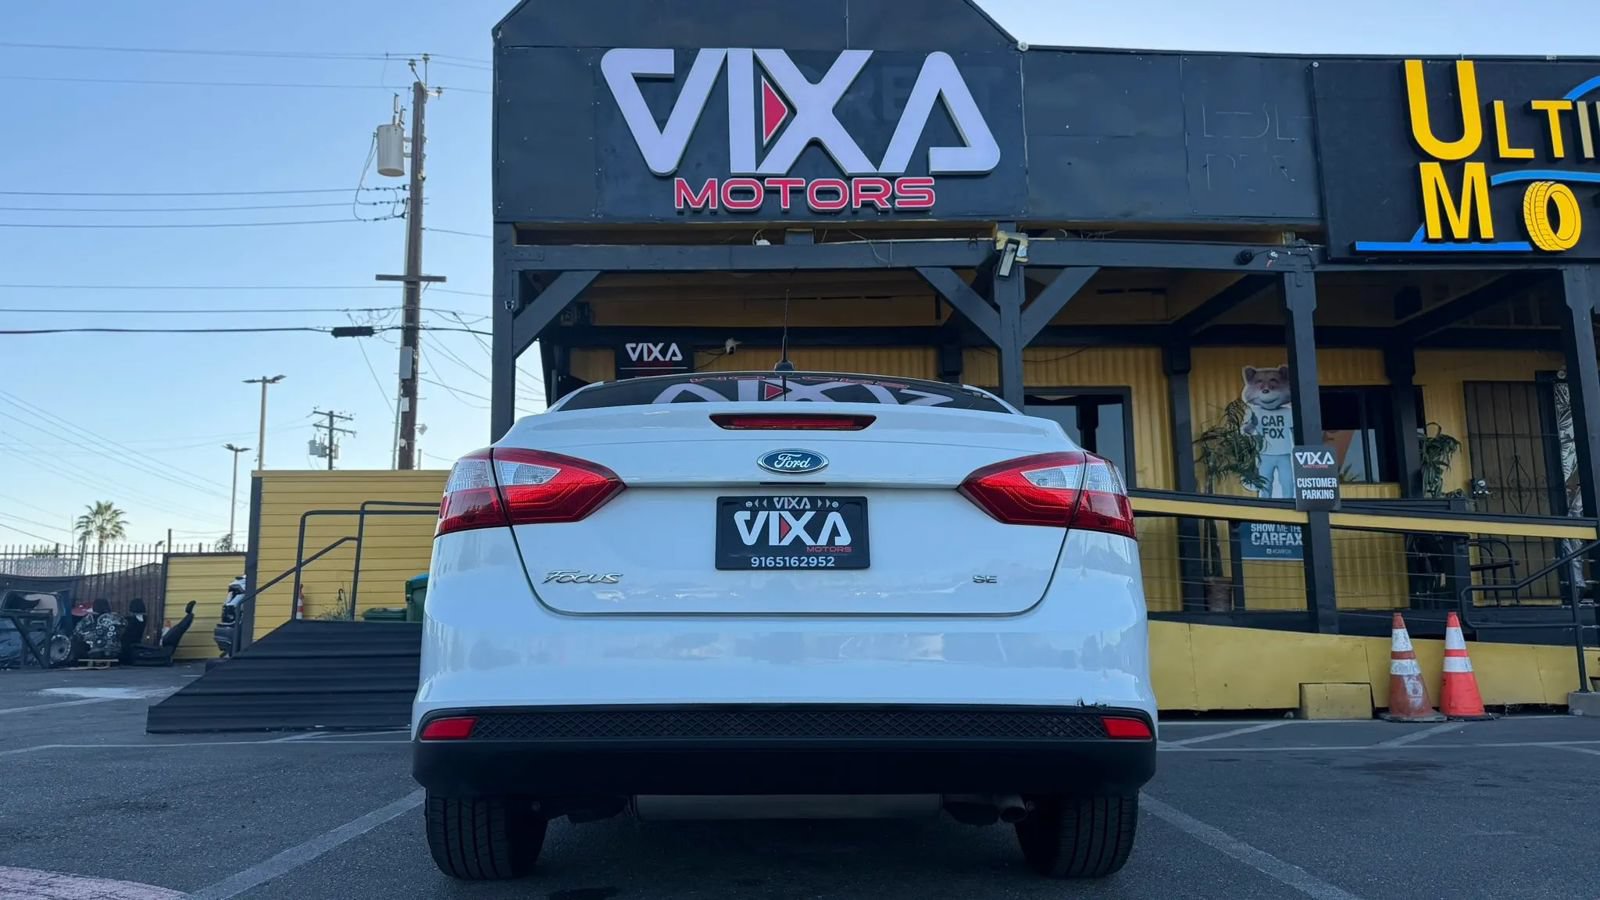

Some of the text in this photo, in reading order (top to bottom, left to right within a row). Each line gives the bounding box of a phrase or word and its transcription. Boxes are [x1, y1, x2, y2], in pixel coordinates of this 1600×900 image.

[600, 47, 1001, 176] VIXA
[1404, 59, 1600, 161] ULTI
[674, 177, 937, 213] MOTORS
[625, 342, 683, 362] VIXA
[1261, 415, 1285, 427] CAR
[1262, 427, 1285, 439] FOX
[774, 453, 812, 468] Ford
[1294, 451, 1335, 465] VIXA
[1296, 477, 1338, 488] CUSTOMER
[1301, 489, 1335, 500] PARKING
[773, 497, 811, 510] VIXA
[733, 510, 852, 546] VIXA
[1250, 523, 1275, 532] SHOW
[1250, 532, 1303, 546] CARFAX
[751, 556, 836, 567] 9165162952
[972, 575, 998, 584] SE
